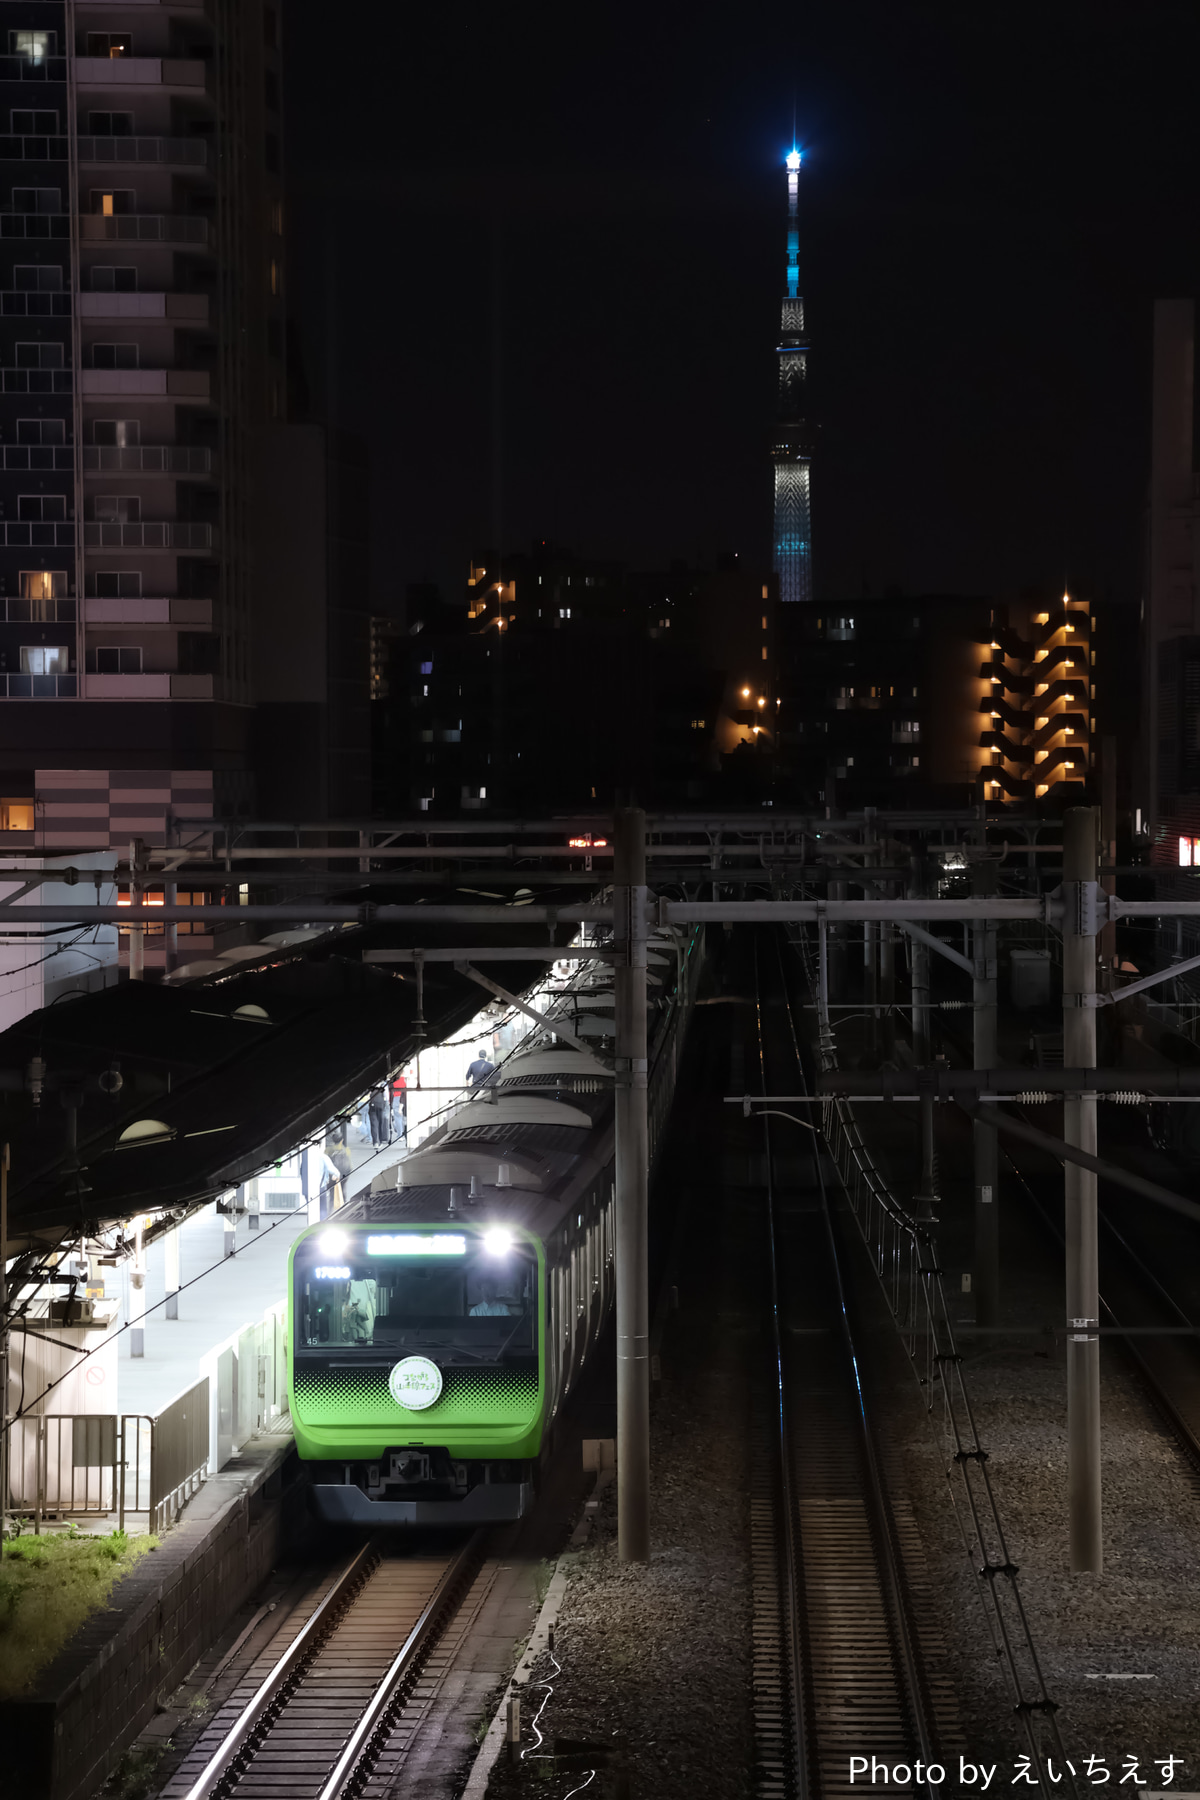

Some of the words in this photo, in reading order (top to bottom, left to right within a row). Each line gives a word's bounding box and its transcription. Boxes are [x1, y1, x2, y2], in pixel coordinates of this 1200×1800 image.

[306, 1337, 318, 1346] 45
[396, 1381, 436, 1391] 山手線フェス
